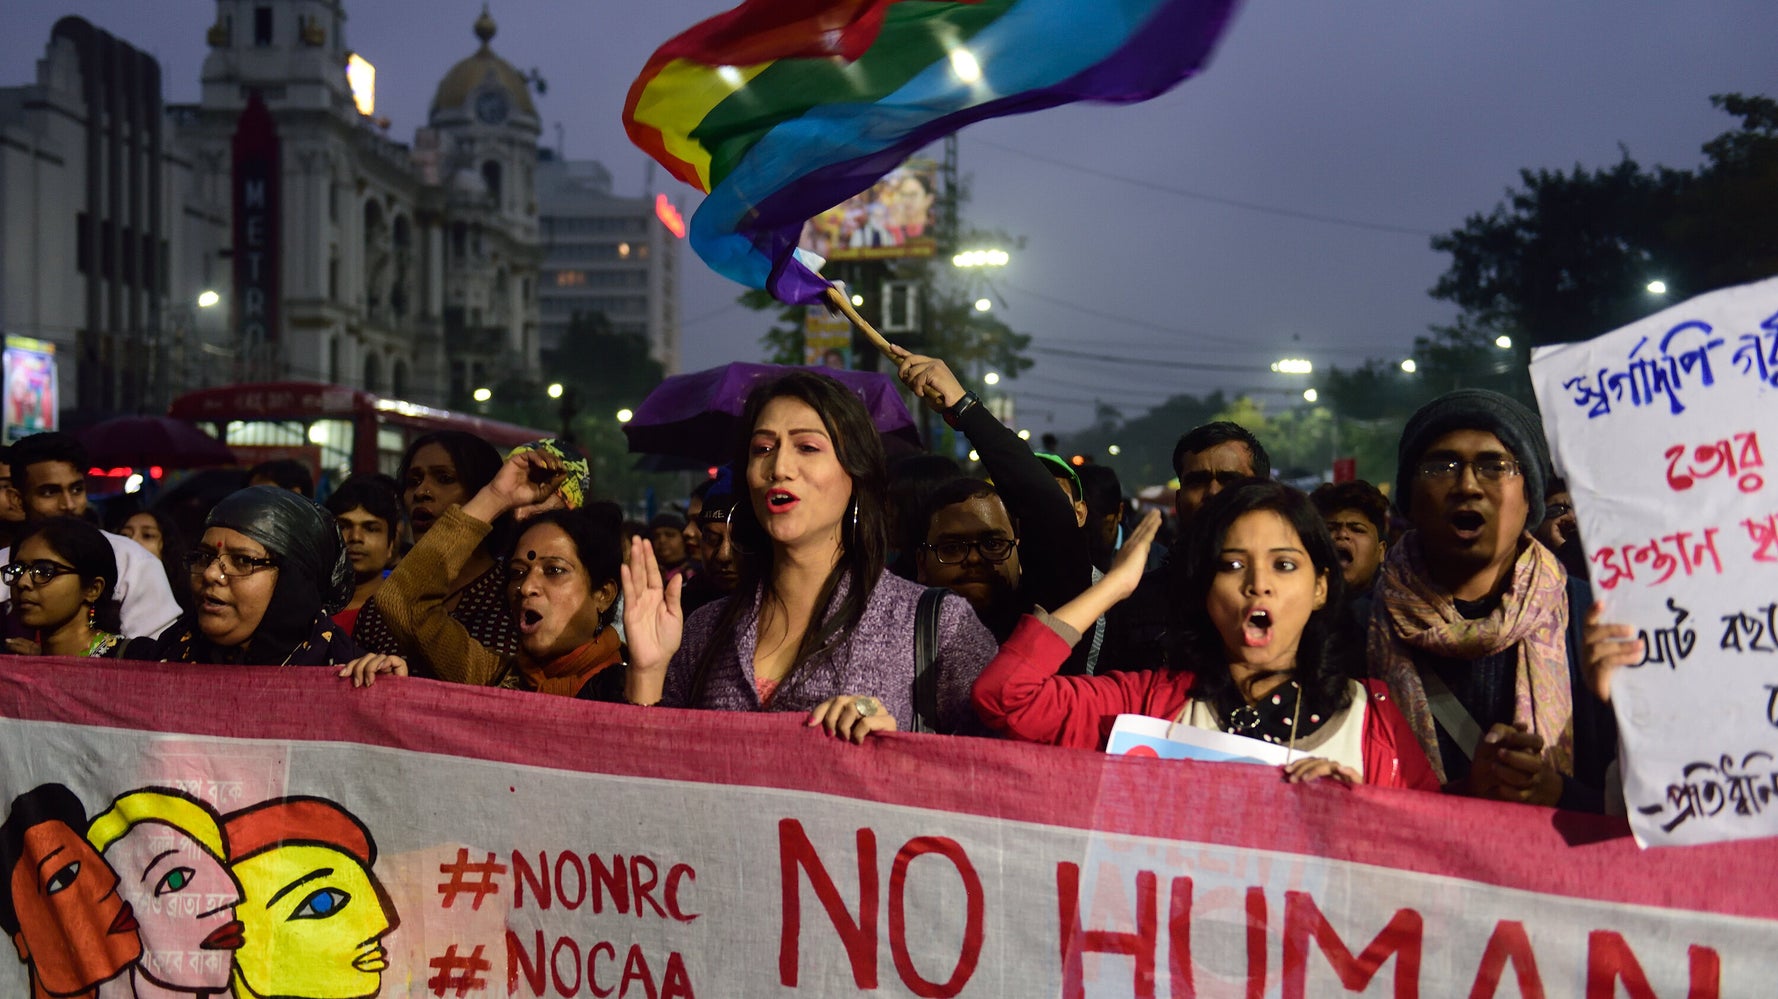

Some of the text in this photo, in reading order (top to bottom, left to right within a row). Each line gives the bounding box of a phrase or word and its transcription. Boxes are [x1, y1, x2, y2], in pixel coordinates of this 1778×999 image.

[243, 176, 267, 357] METRO
[438, 847, 701, 923] #NONRC
[778, 817, 985, 999] NO
[428, 929, 697, 999] #NOCAA
